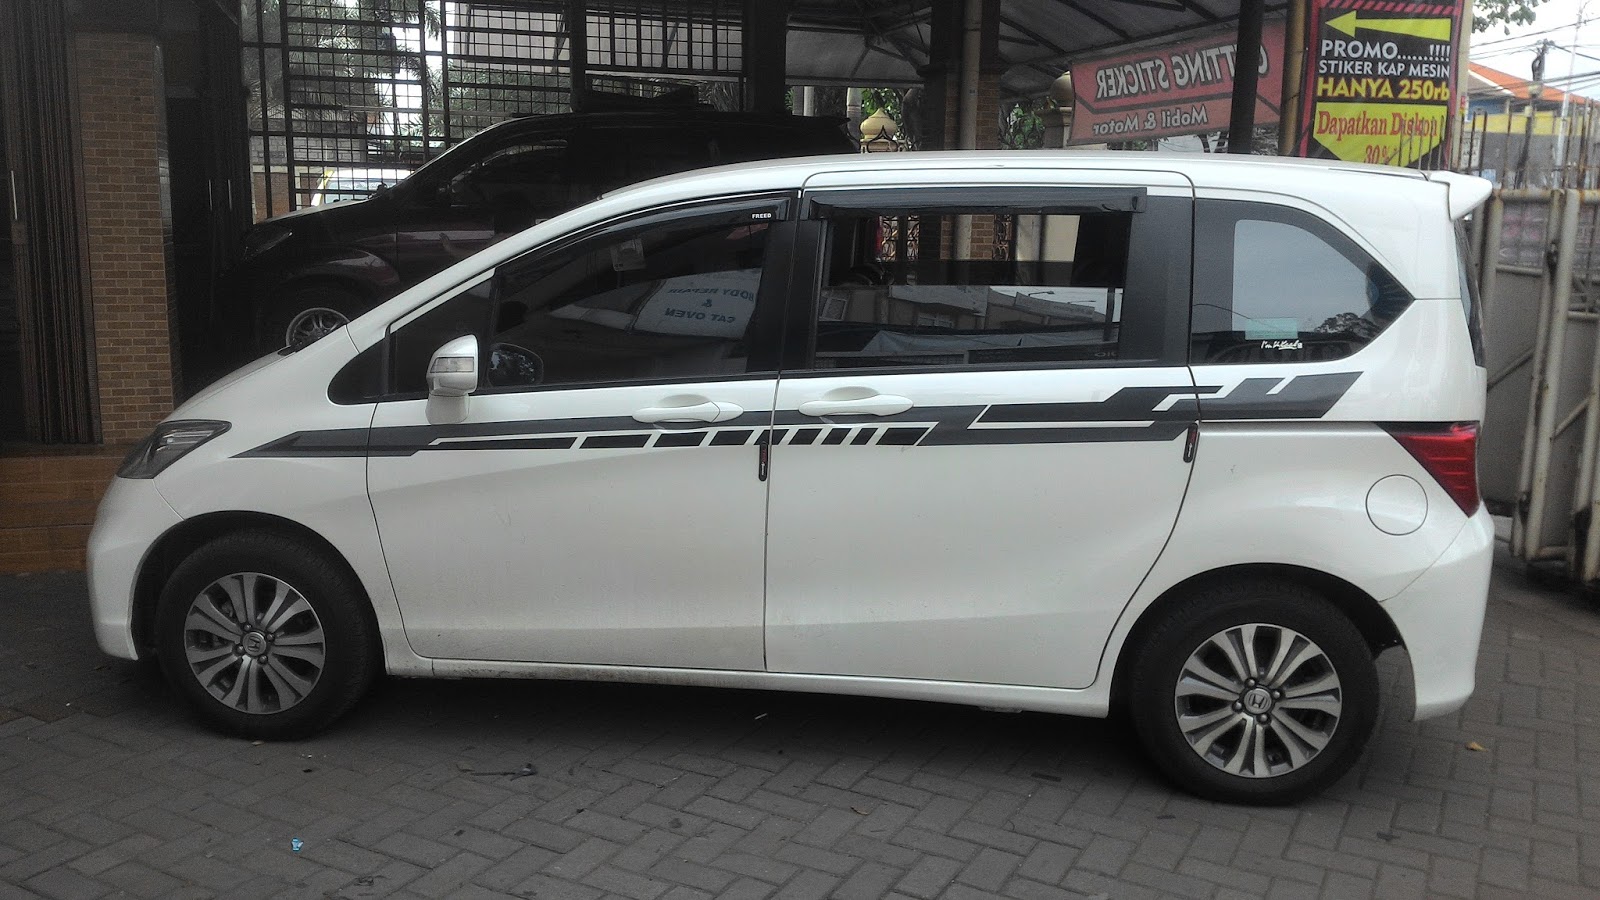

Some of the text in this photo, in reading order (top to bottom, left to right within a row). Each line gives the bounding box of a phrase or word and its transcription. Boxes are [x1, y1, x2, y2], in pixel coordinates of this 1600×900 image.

[1318, 60, 1450, 78] STIKER KAP MESIN
[1316, 76, 1450, 101] HANYA 250rb
[1317, 110, 1438, 141] Dapatkan Diskon
